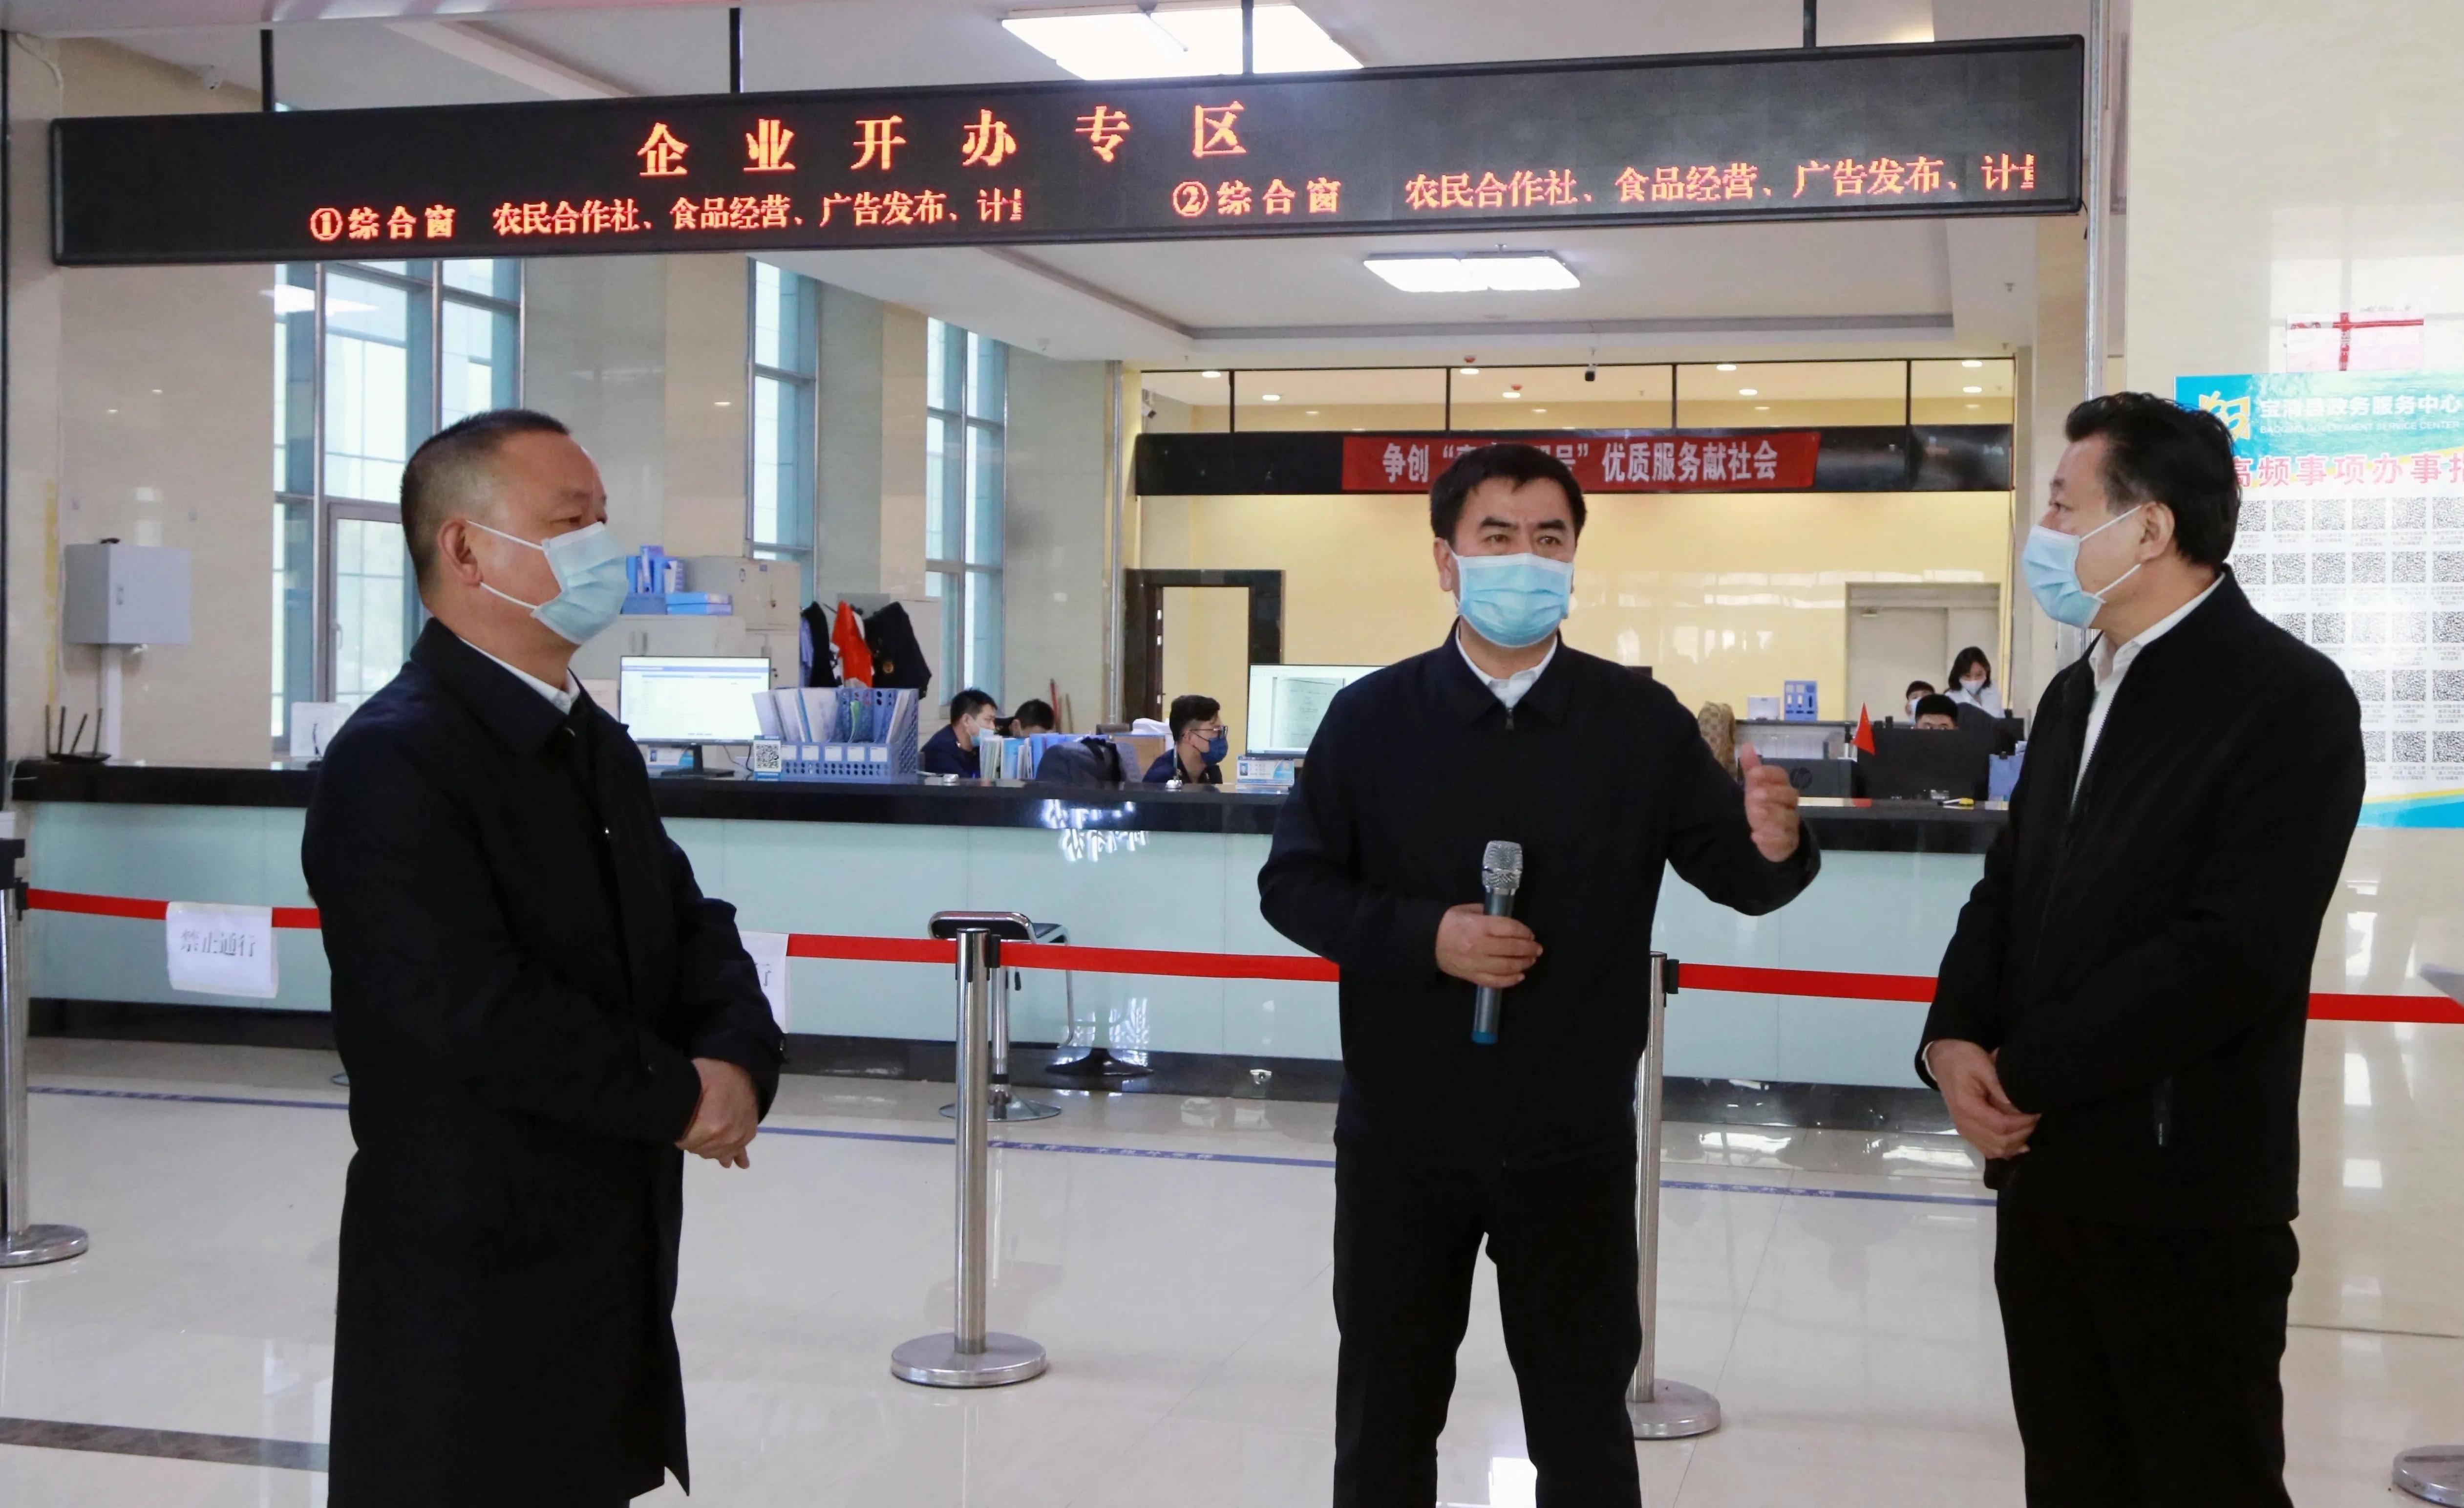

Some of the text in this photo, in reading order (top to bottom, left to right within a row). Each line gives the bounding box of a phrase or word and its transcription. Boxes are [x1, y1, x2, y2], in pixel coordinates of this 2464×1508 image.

[637, 101, 1247, 176] 企业开办专区
[2420, 420, 2460, 429] CENTER
[180, 928, 256, 957] 禁止通行
